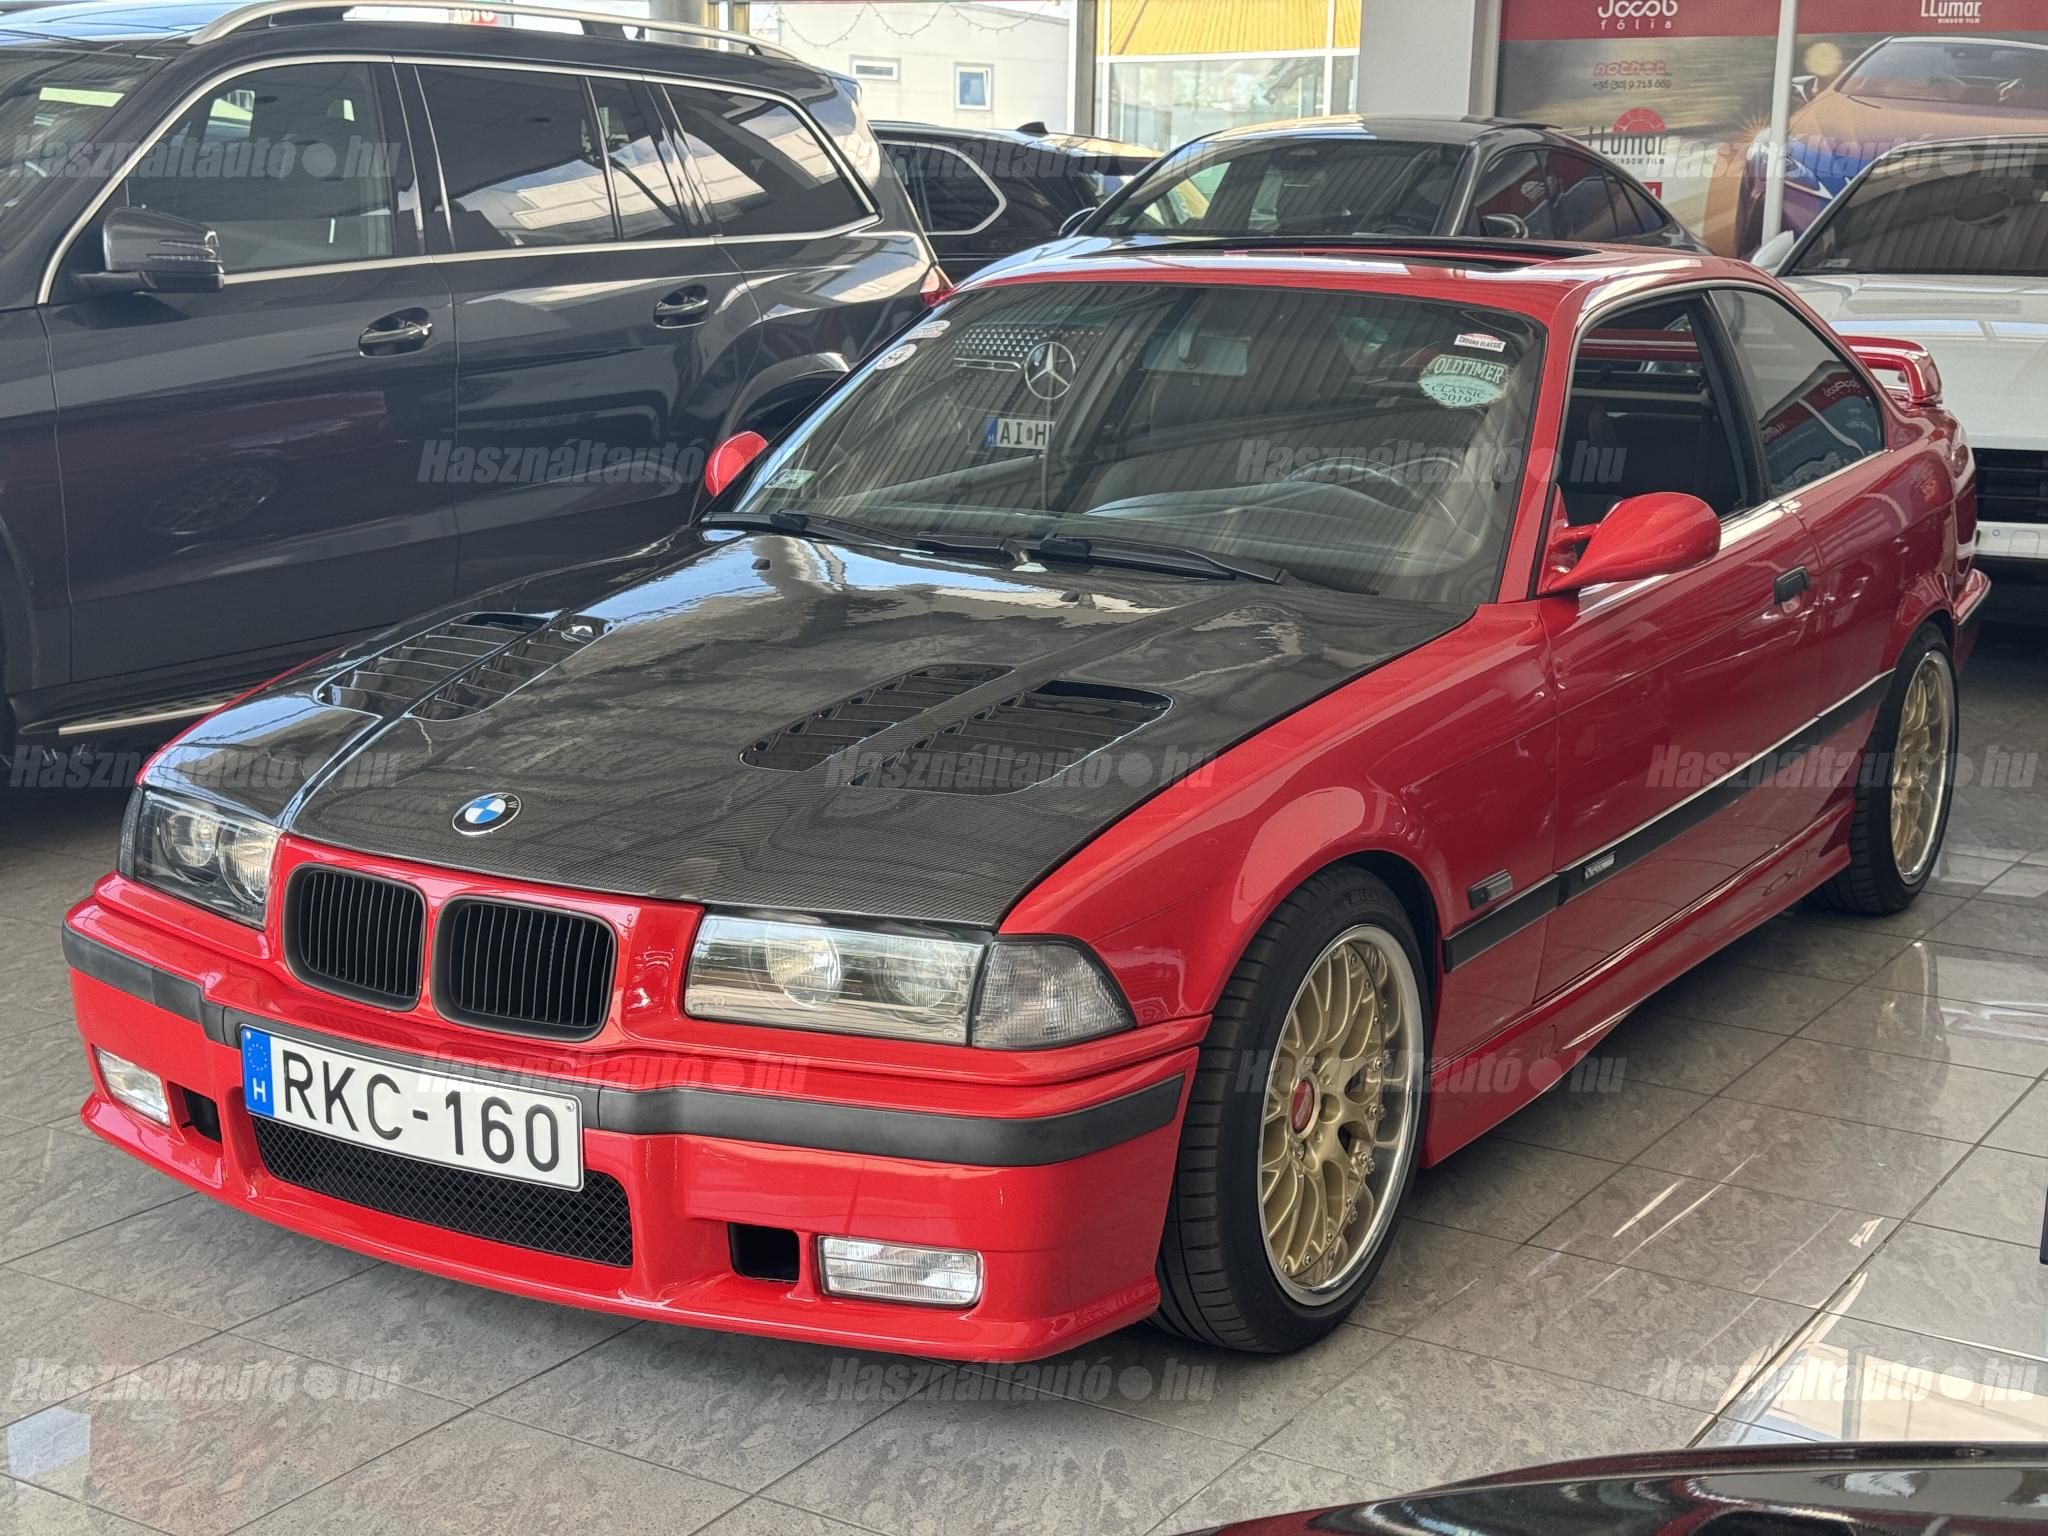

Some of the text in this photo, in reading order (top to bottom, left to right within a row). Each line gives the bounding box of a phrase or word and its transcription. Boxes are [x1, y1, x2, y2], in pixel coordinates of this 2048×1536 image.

[1434, 358, 1504, 384] OLDTIMER
[1439, 392, 1472, 403] 2019
[252, 1049, 560, 1173] H RKC-160
